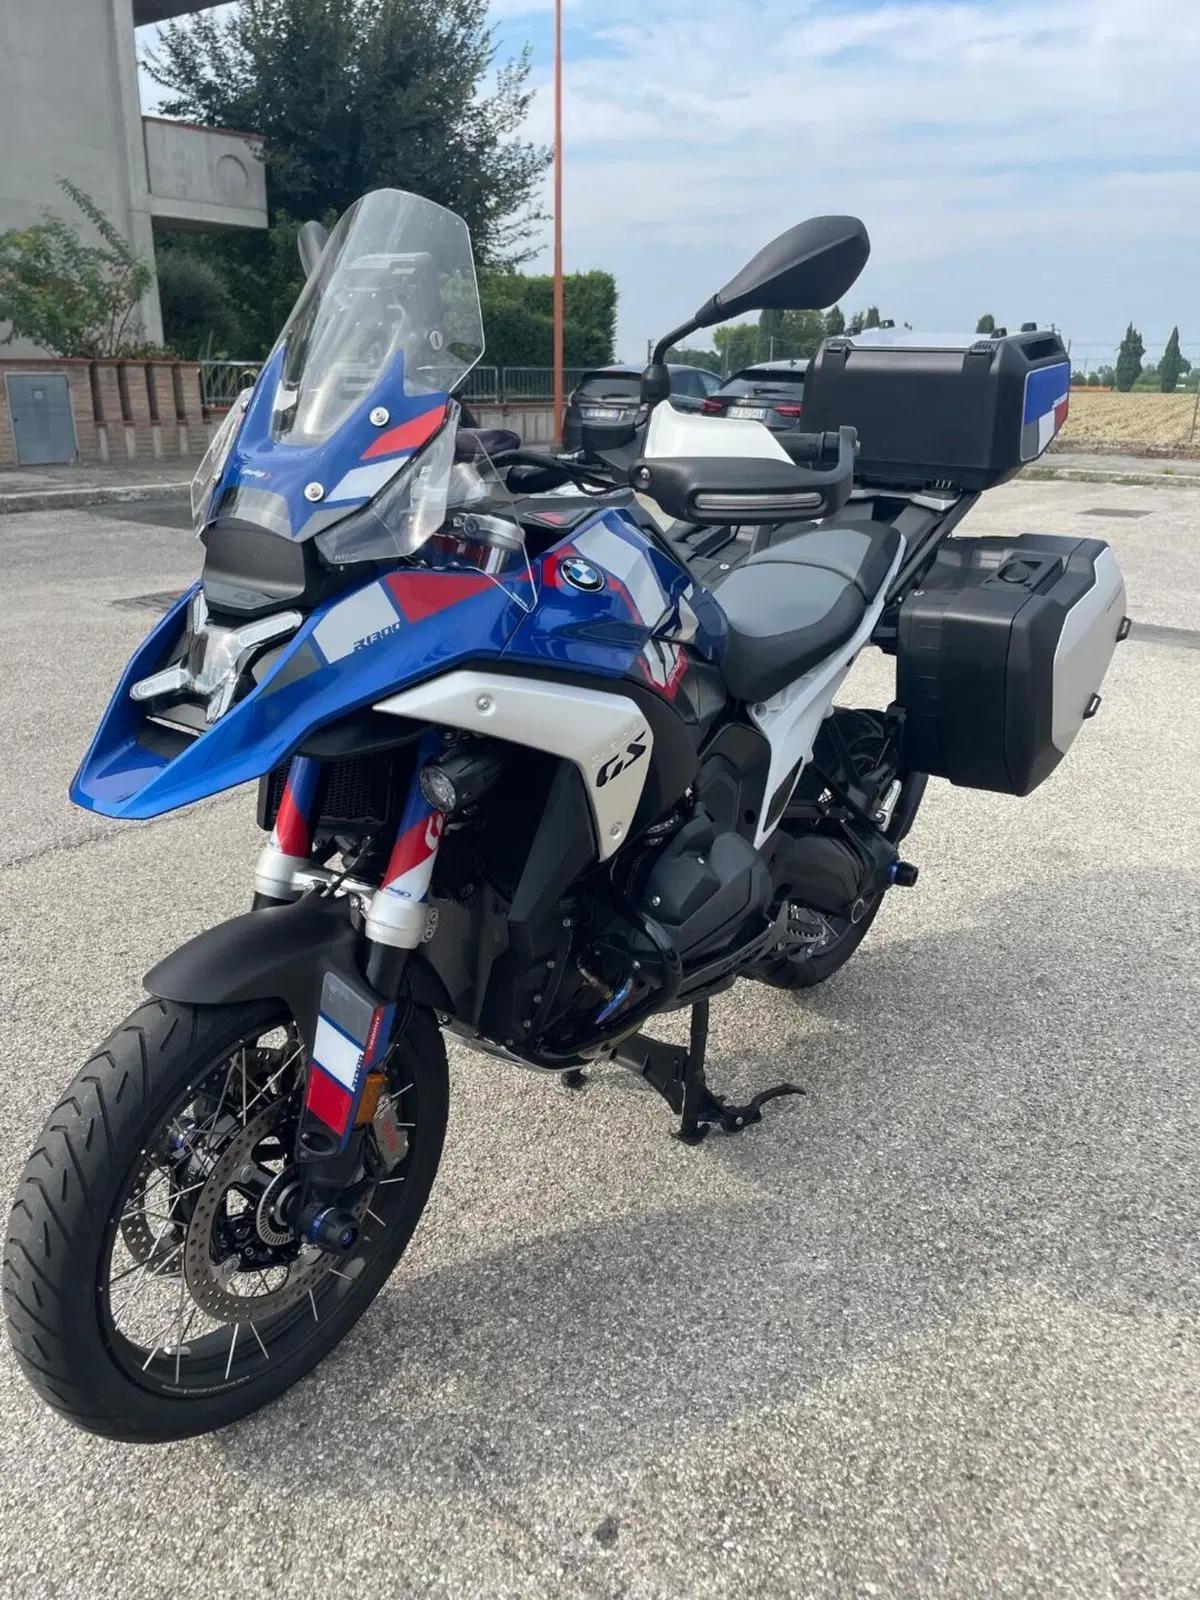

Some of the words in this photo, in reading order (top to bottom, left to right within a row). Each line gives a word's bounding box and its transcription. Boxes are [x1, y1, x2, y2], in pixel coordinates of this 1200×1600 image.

[352, 621, 401, 651] R1300
[596, 730, 647, 787] GS
[368, 1015, 380, 1050] TROPHY
